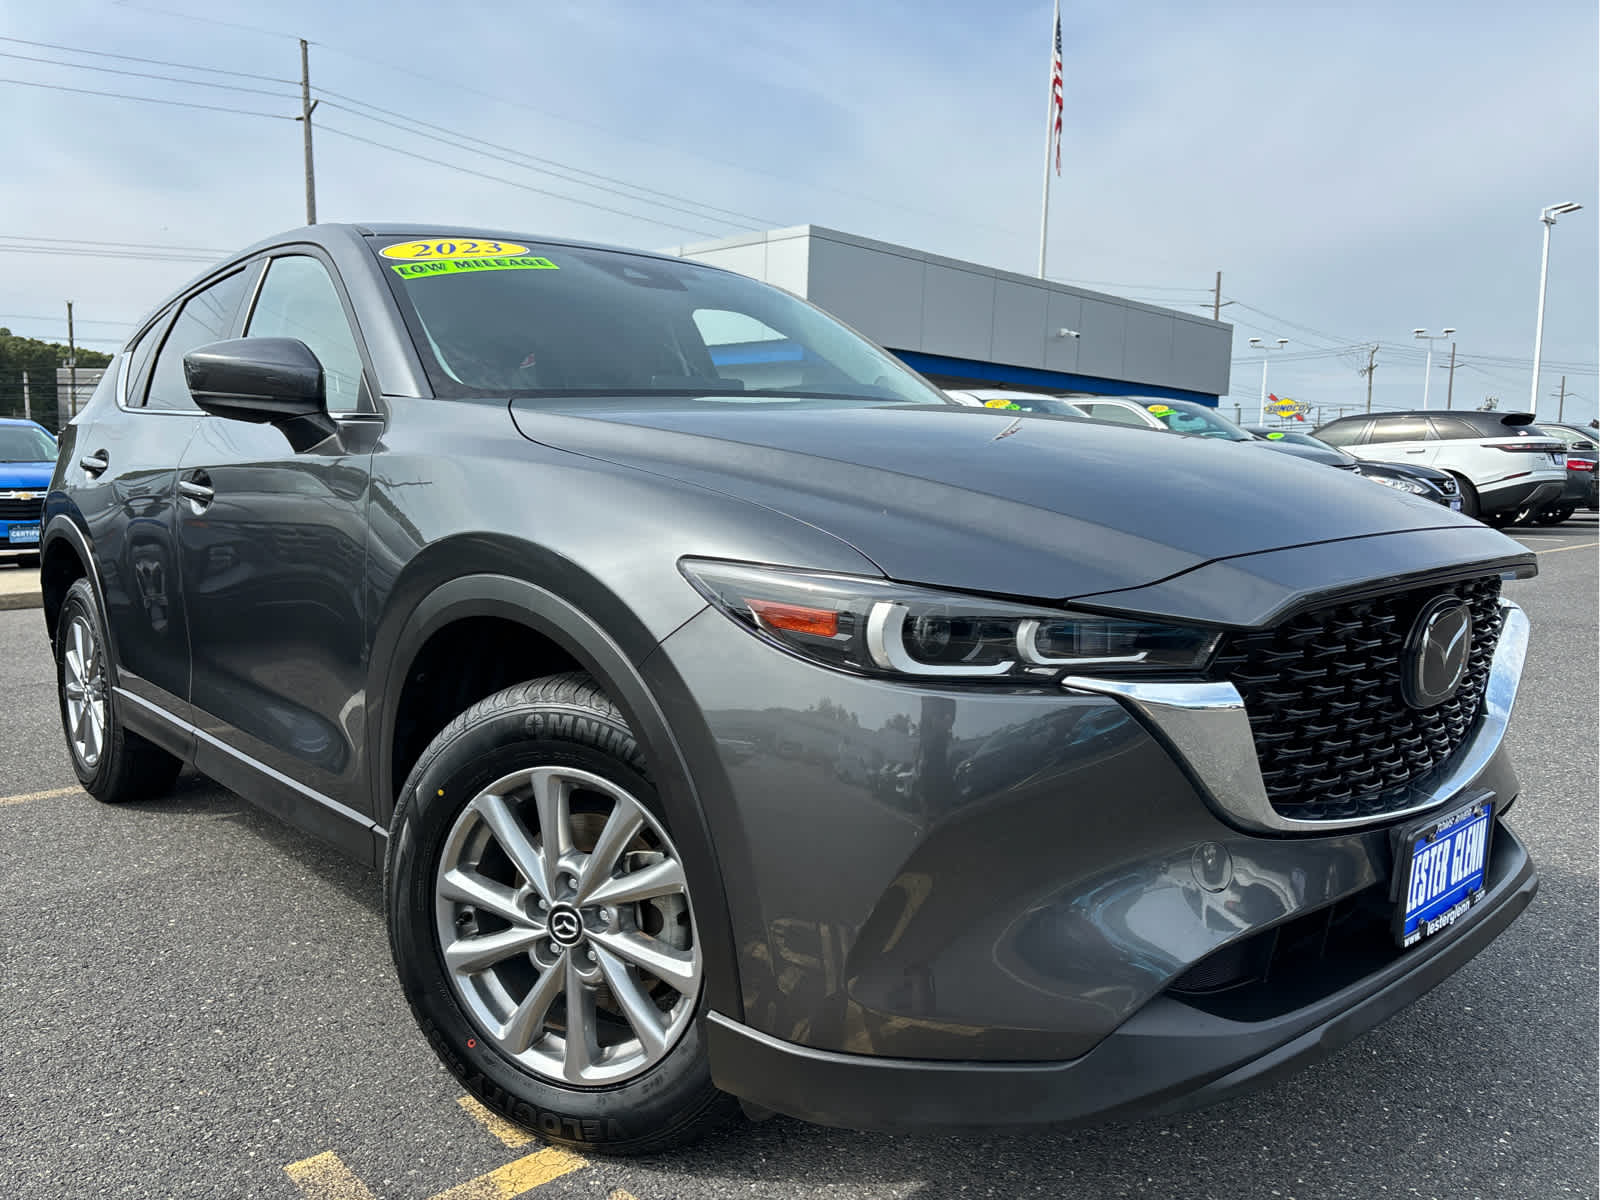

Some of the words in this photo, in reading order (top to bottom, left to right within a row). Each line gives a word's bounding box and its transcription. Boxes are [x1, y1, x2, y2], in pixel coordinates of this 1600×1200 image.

[412, 242, 502, 257] 2023
[398, 263, 447, 275] LOW
[455, 257, 552, 269] MILEAGE
[1265, 403, 1306, 414] SUNOCO
[1407, 839, 1450, 913] LESTER
[1452, 818, 1487, 885] GLENN
[1427, 900, 1470, 936] lesterglenn
